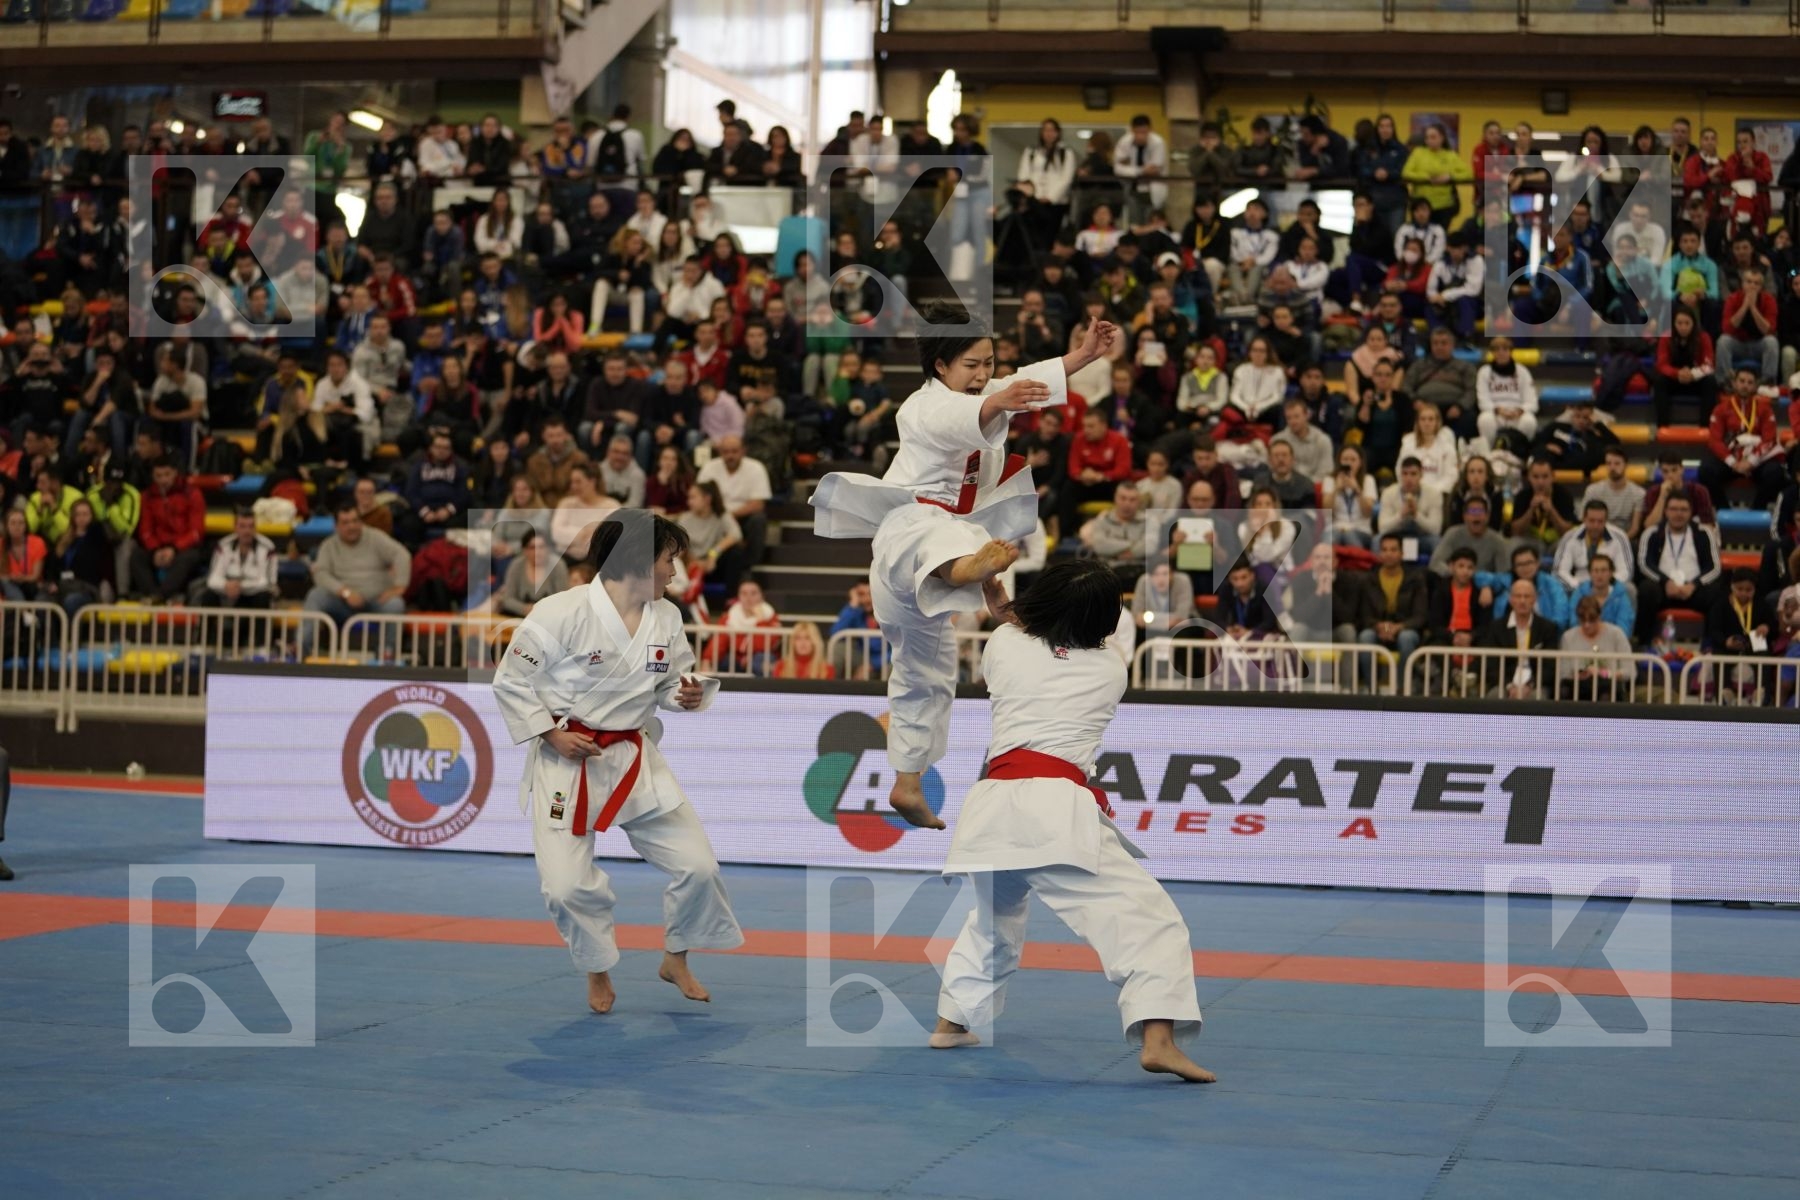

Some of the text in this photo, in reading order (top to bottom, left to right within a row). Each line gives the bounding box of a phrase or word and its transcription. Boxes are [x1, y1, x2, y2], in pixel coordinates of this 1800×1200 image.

[521, 654, 538, 666] JAL
[647, 663, 668, 672] JAPAN
[395, 686, 446, 704] WORLD
[381, 749, 452, 781] WKF
[978, 748, 1555, 845] ARATE1
[355, 798, 479, 845] KARATE FEDERATION
[1338, 817, 1378, 839] A
